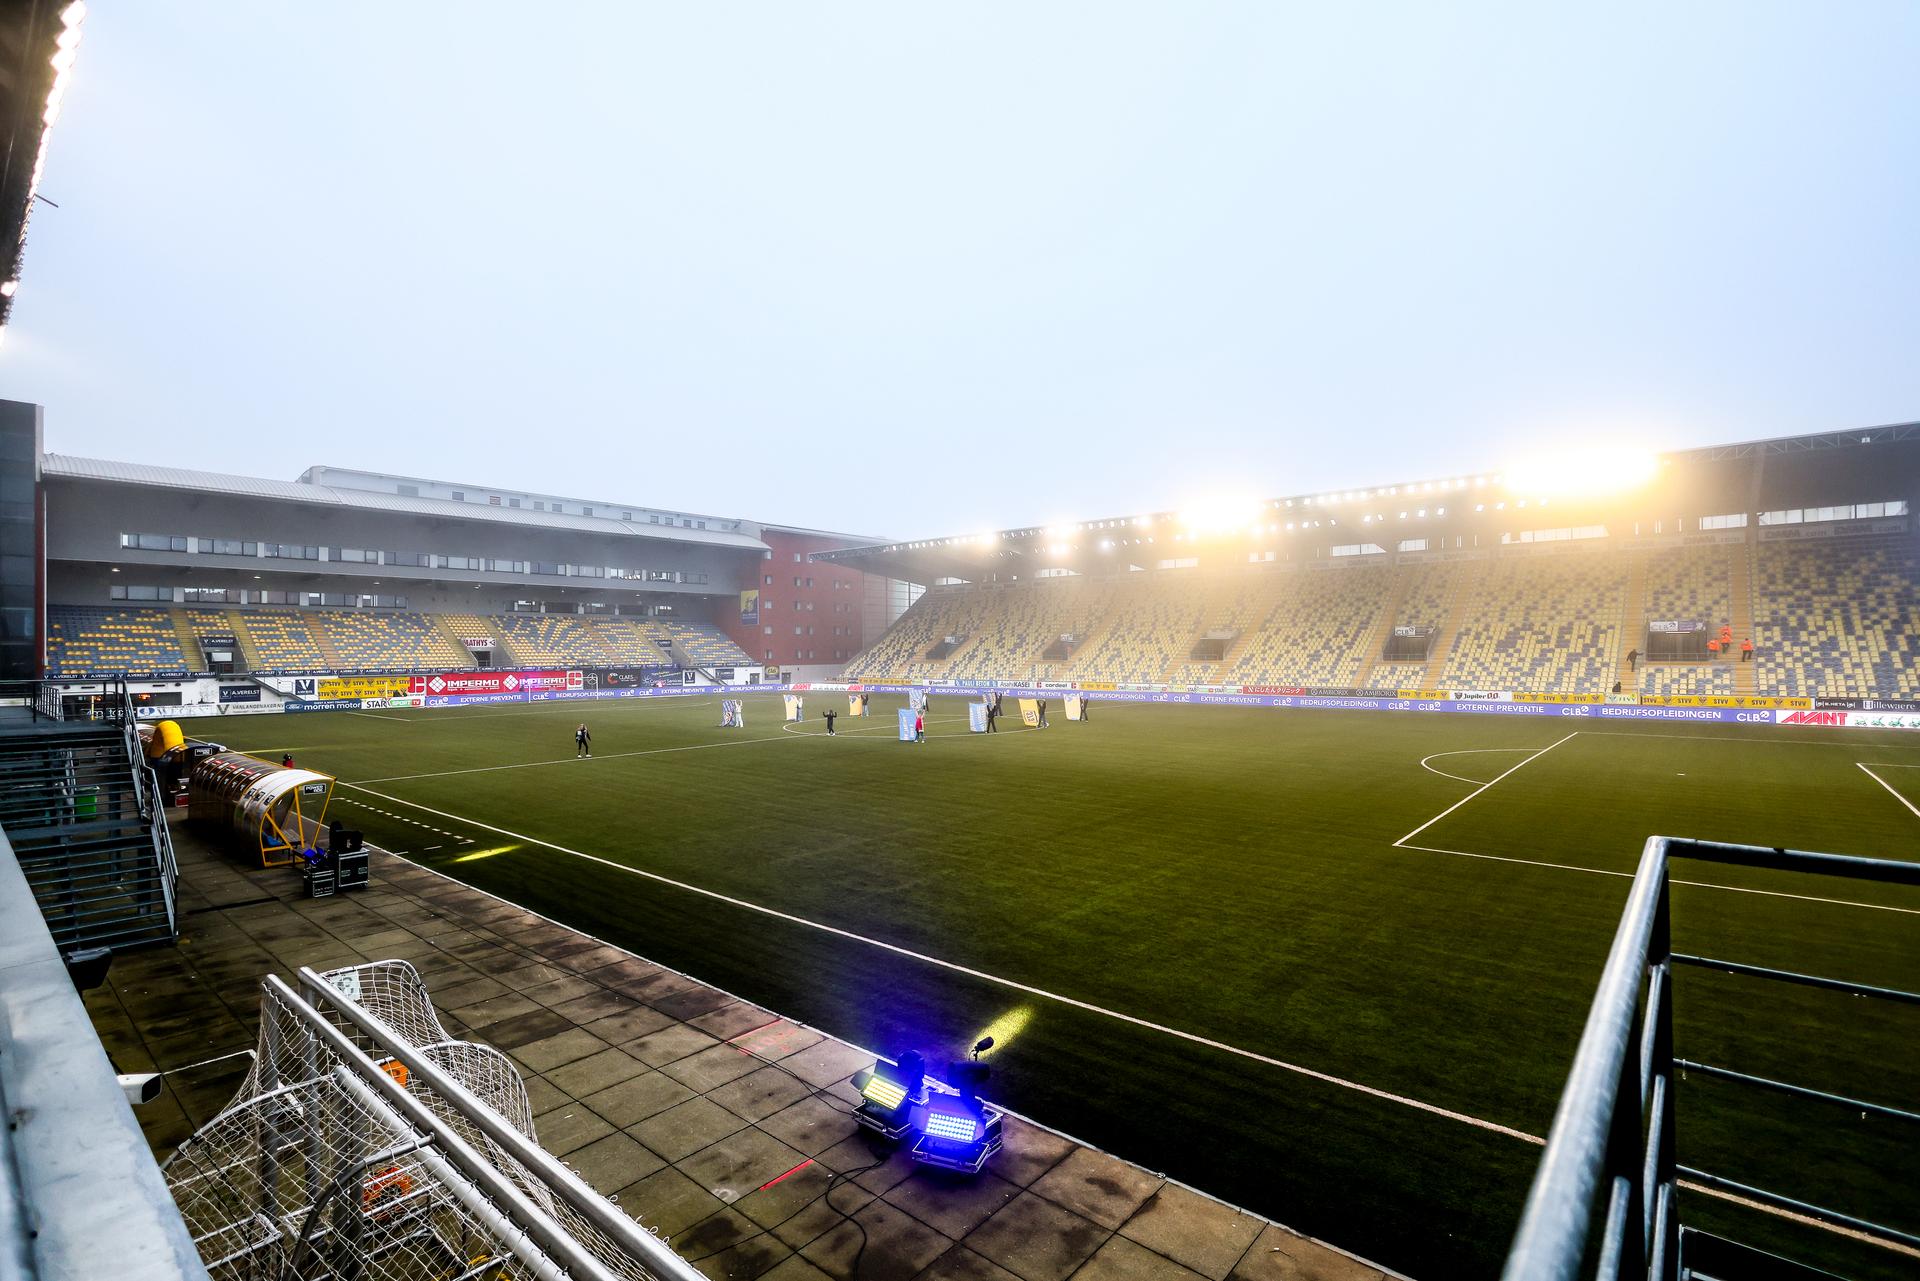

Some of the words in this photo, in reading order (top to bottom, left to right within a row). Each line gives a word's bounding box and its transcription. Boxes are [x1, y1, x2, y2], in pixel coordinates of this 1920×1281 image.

[1602, 708, 1721, 718] BEDRIJFSOPLEIDINGEN
[1736, 713, 1760, 721] CLB
[1781, 712, 1847, 725] AVANT
